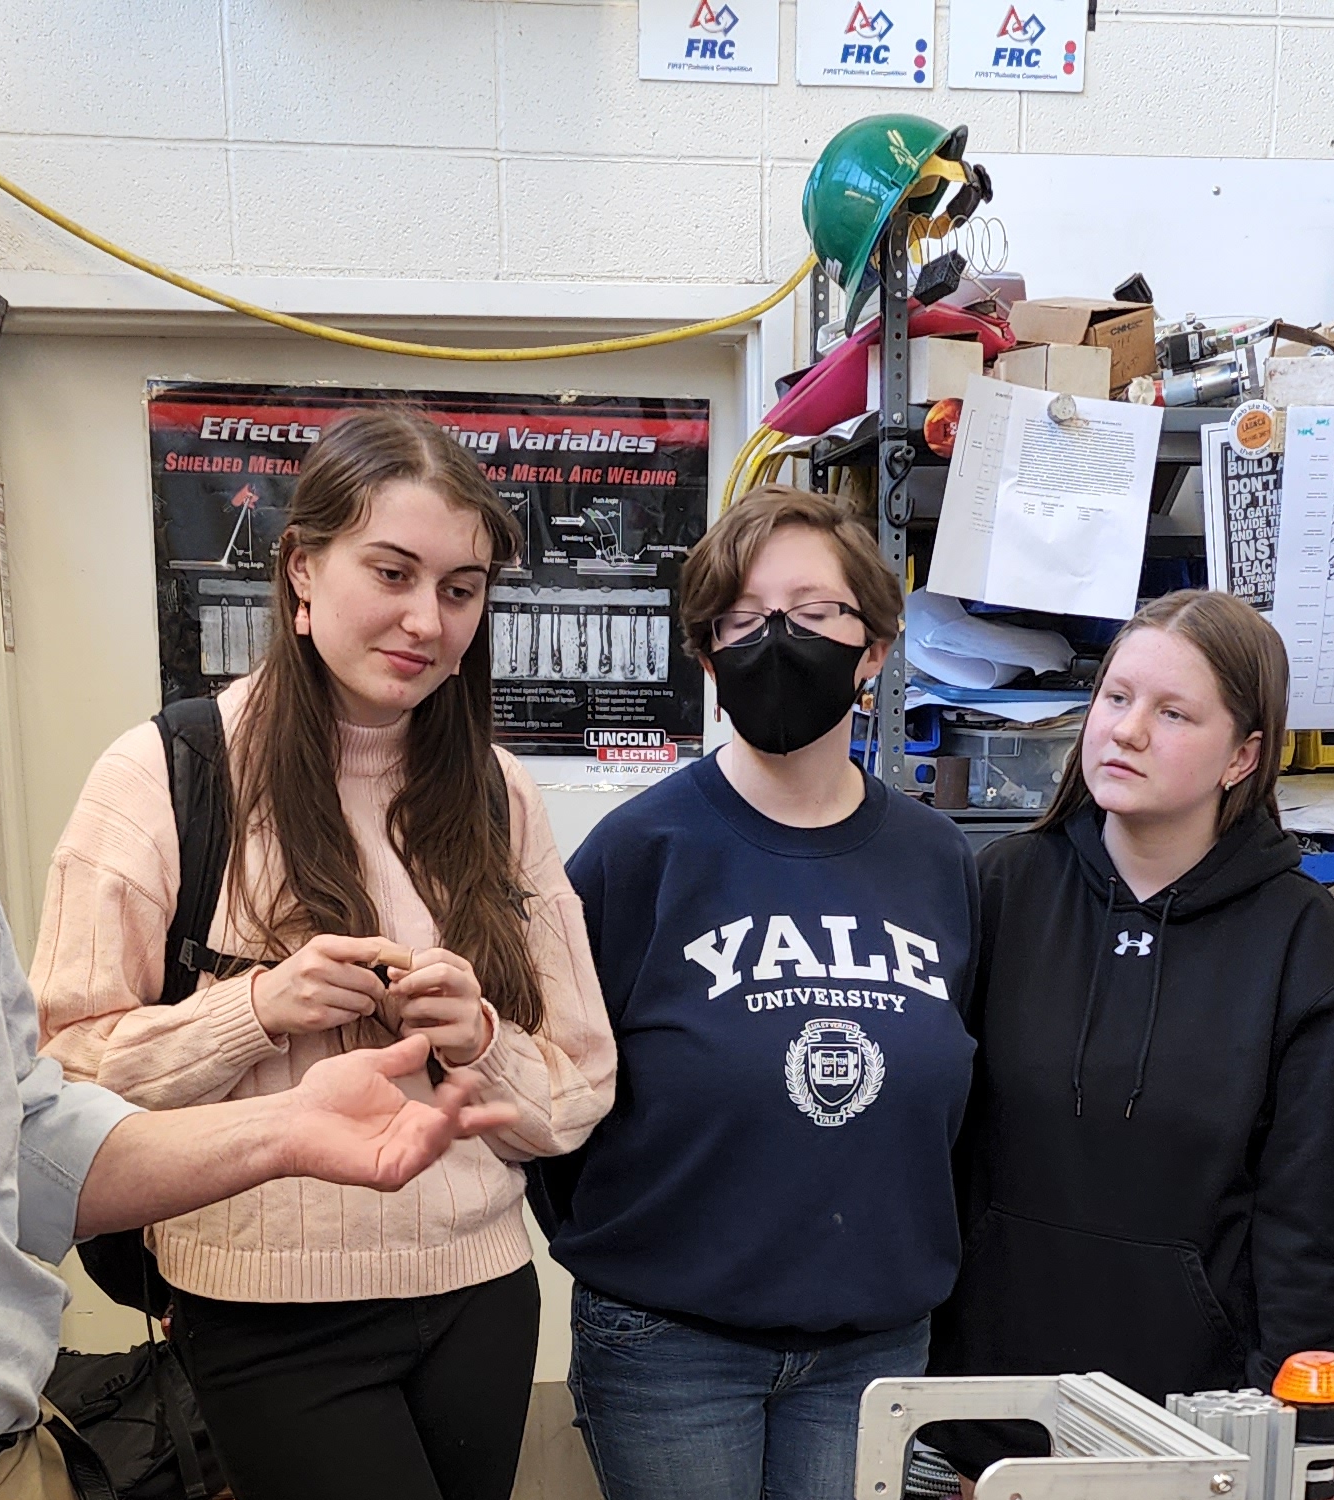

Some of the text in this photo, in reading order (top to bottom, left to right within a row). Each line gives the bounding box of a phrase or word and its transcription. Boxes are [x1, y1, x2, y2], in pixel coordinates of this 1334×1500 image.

[685, 38, 736, 59] FRC
[840, 44, 891, 64] FRC
[992, 47, 1042, 68] FRC
[200, 416, 322, 443] Effects
[507, 427, 657, 454] Variables
[164, 451, 243, 473] SHIELDED
[247, 453, 302, 476] METAL
[510, 463, 564, 483] METAL
[568, 464, 603, 485] ARC
[608, 466, 677, 486] WELDING
[1227, 459, 1273, 477] BUILD
[1228, 474, 1278, 495] DON'T
[1229, 493, 1252, 510] UP
[1229, 509, 1245, 521] TO
[1230, 518, 1267, 532] DIVIDE
[1231, 529, 1254, 543] AND
[1232, 576, 1244, 586] TO
[1233, 583, 1256, 597] AND
[220, 597, 253, 606] A B
[646, 606, 655, 614] H
[589, 731, 661, 747] LINCOLN
[606, 749, 670, 761] ELECTRIC
[586, 765, 676, 774] THE WELDING EXPERTS
[684, 914, 950, 1001] YALE
[745, 987, 907, 1013] UNIVERSITY
[818, 1115, 841, 1125] YALE
